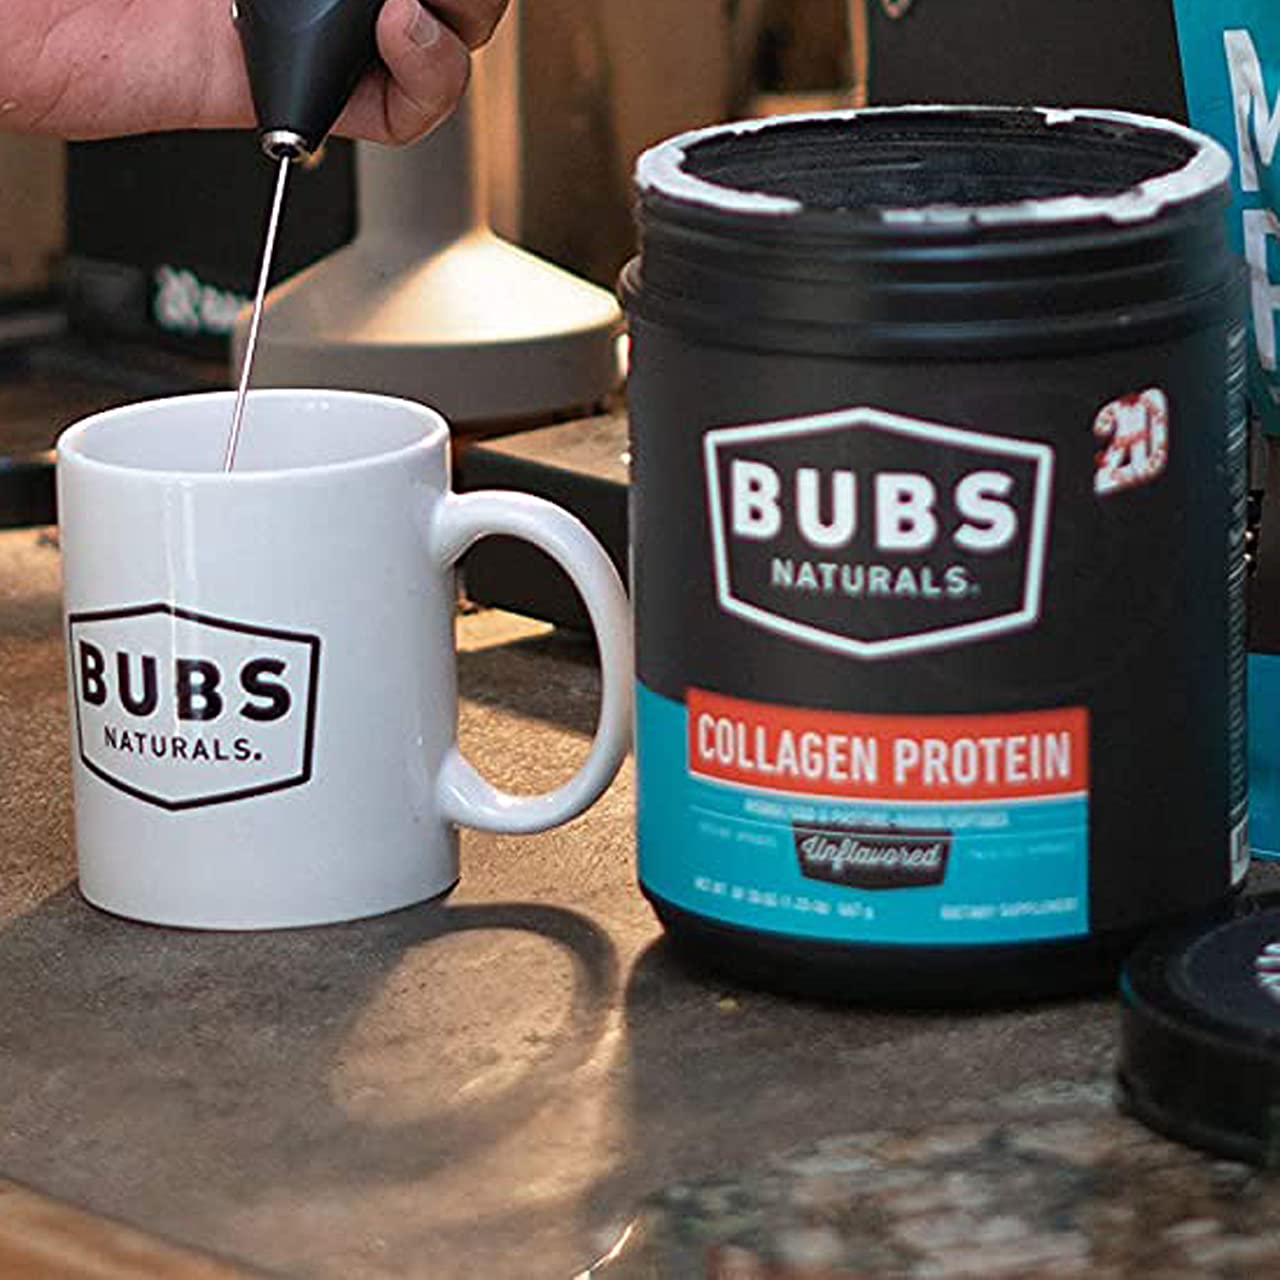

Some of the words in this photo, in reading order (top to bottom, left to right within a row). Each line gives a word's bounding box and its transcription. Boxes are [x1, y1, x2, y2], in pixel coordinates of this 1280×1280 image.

[731, 458, 1018, 552] BUBS
[78, 639, 293, 722] BUBS
[697, 712, 878, 783] COLLAGEN
[892, 730, 1071, 787] PROTEIN
[800, 834, 943, 871] Unflavored
